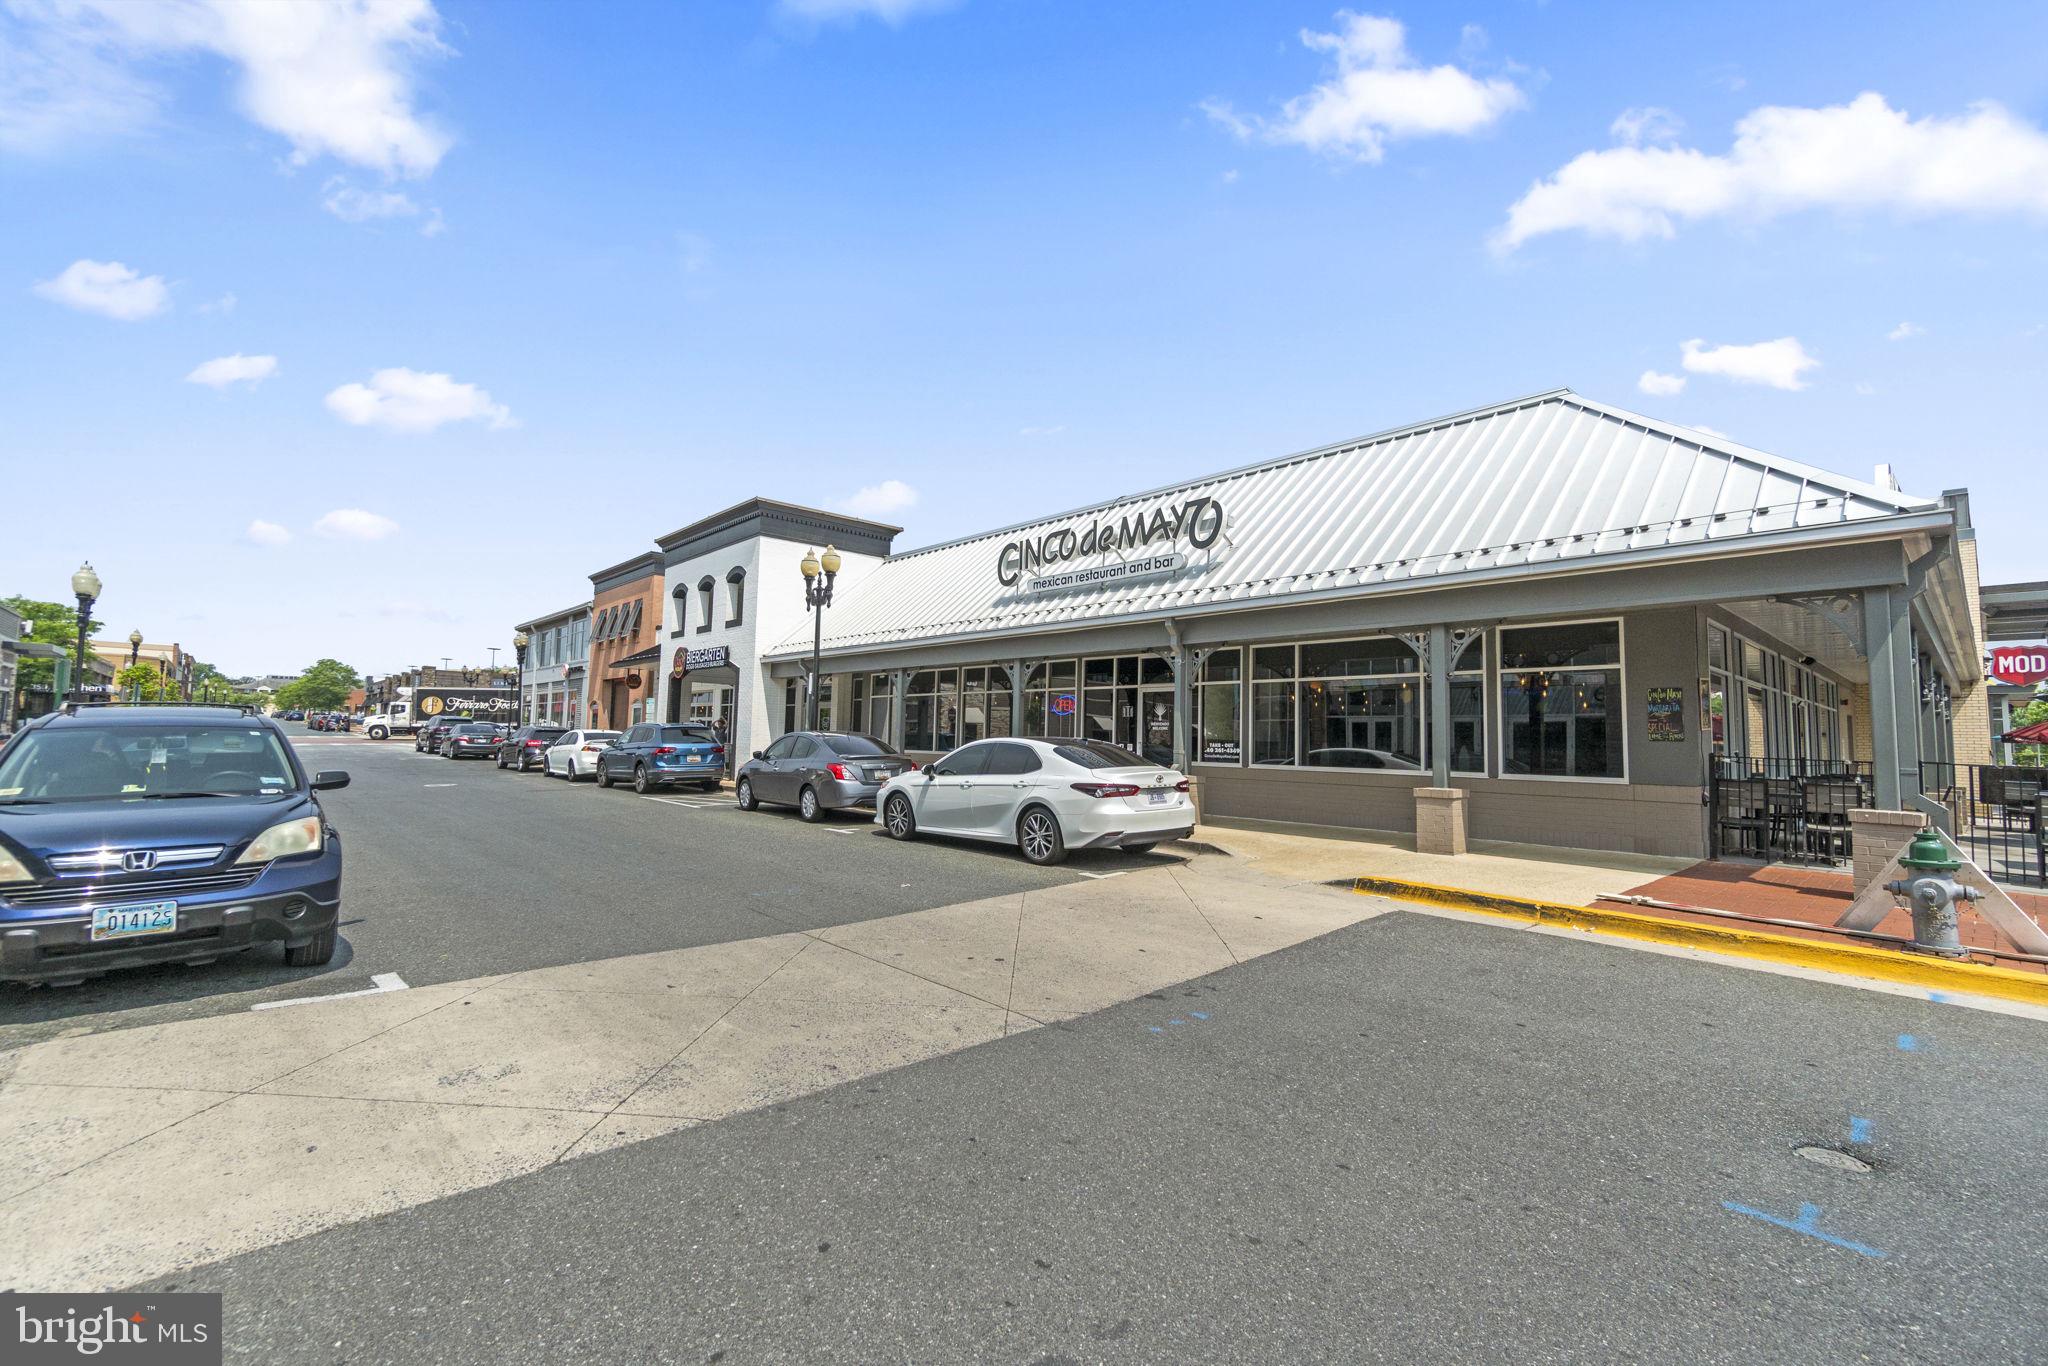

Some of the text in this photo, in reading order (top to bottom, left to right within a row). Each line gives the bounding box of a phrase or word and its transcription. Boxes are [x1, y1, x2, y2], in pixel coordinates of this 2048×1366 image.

[998, 497, 1223, 587] CINCO de MAYO
[1033, 556, 1175, 589] mexican restaurant and bar
[687, 646, 725, 664] BIERGARTEN
[1998, 655, 2046, 673] MOD
